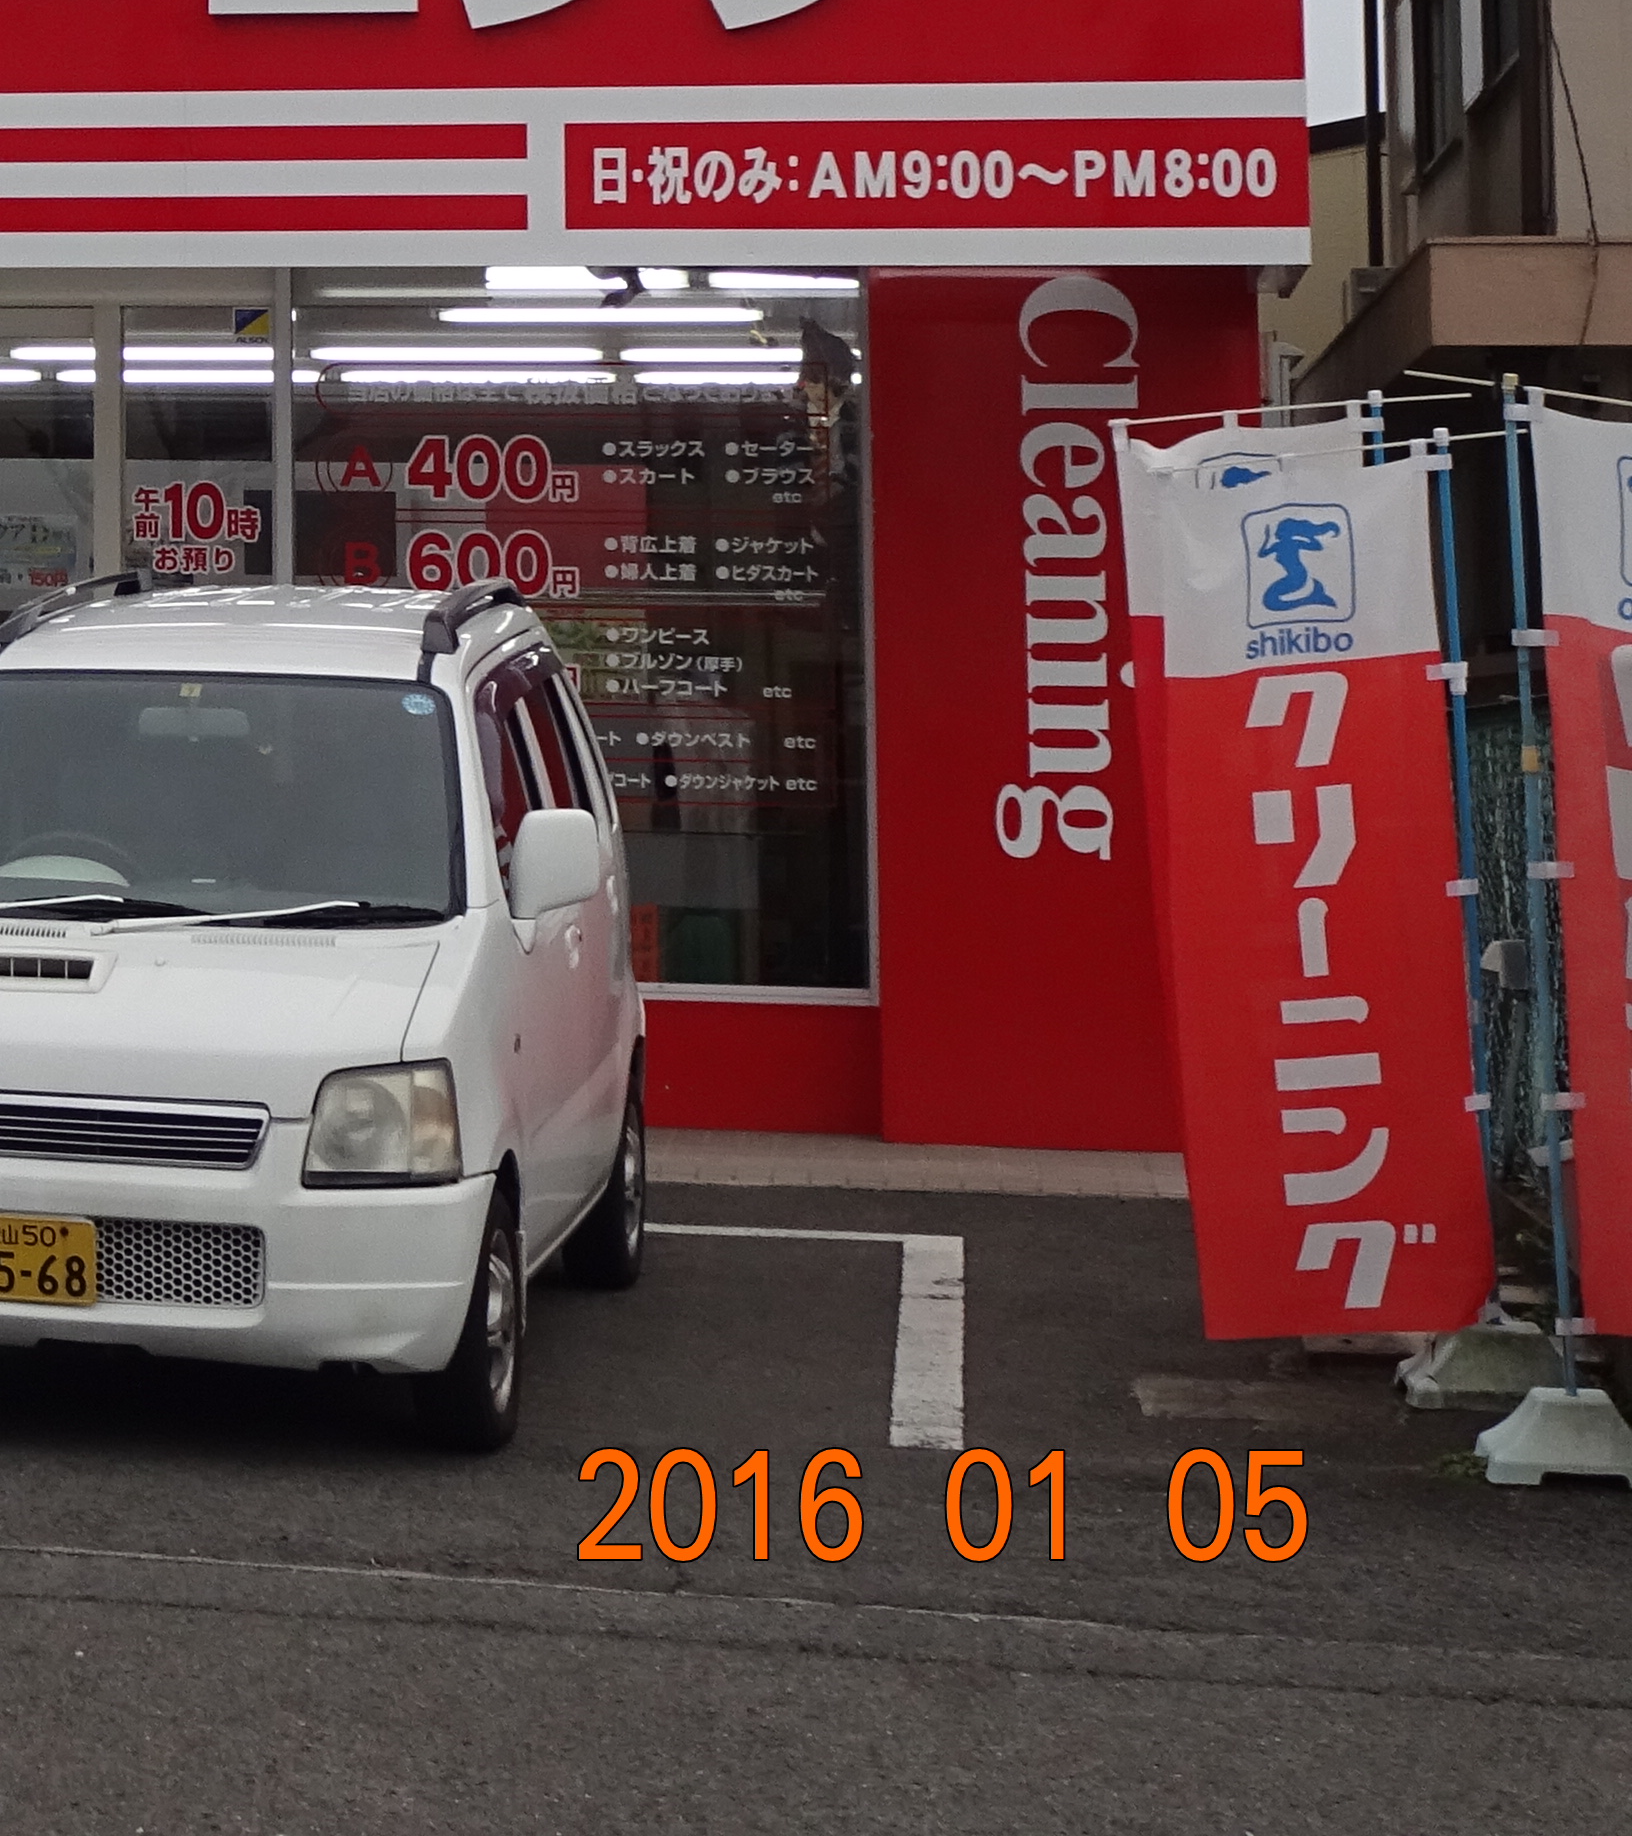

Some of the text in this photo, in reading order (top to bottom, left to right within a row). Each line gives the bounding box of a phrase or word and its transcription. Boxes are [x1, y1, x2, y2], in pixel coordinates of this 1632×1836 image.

[617, 440, 814, 457] スラックス セーター
[340, 442, 382, 487] A
[405, 434, 579, 503] 400円
[619, 468, 816, 485] スカート ブラウス
[772, 491, 803, 504] etc
[620, 535, 814, 555] 背広上着 ジャケット
[153, 544, 236, 575] お預り
[344, 541, 382, 586] B
[407, 530, 580, 599] 600円
[996, 275, 1140, 862] Cleaning
[620, 563, 819, 583] 婦人上着 ヒダスカート
[620, 627, 711, 646] ワンピース
[1245, 627, 1354, 659] shikibo
[622, 677, 793, 699] ハーフコート etc
[651, 730, 751, 748] ダウンベスト
[783, 736, 817, 750] etc
[678, 773, 780, 791] ダウンジャケット
[785, 777, 818, 792] etc
[1244, 670, 1437, 1310] クリーニング
